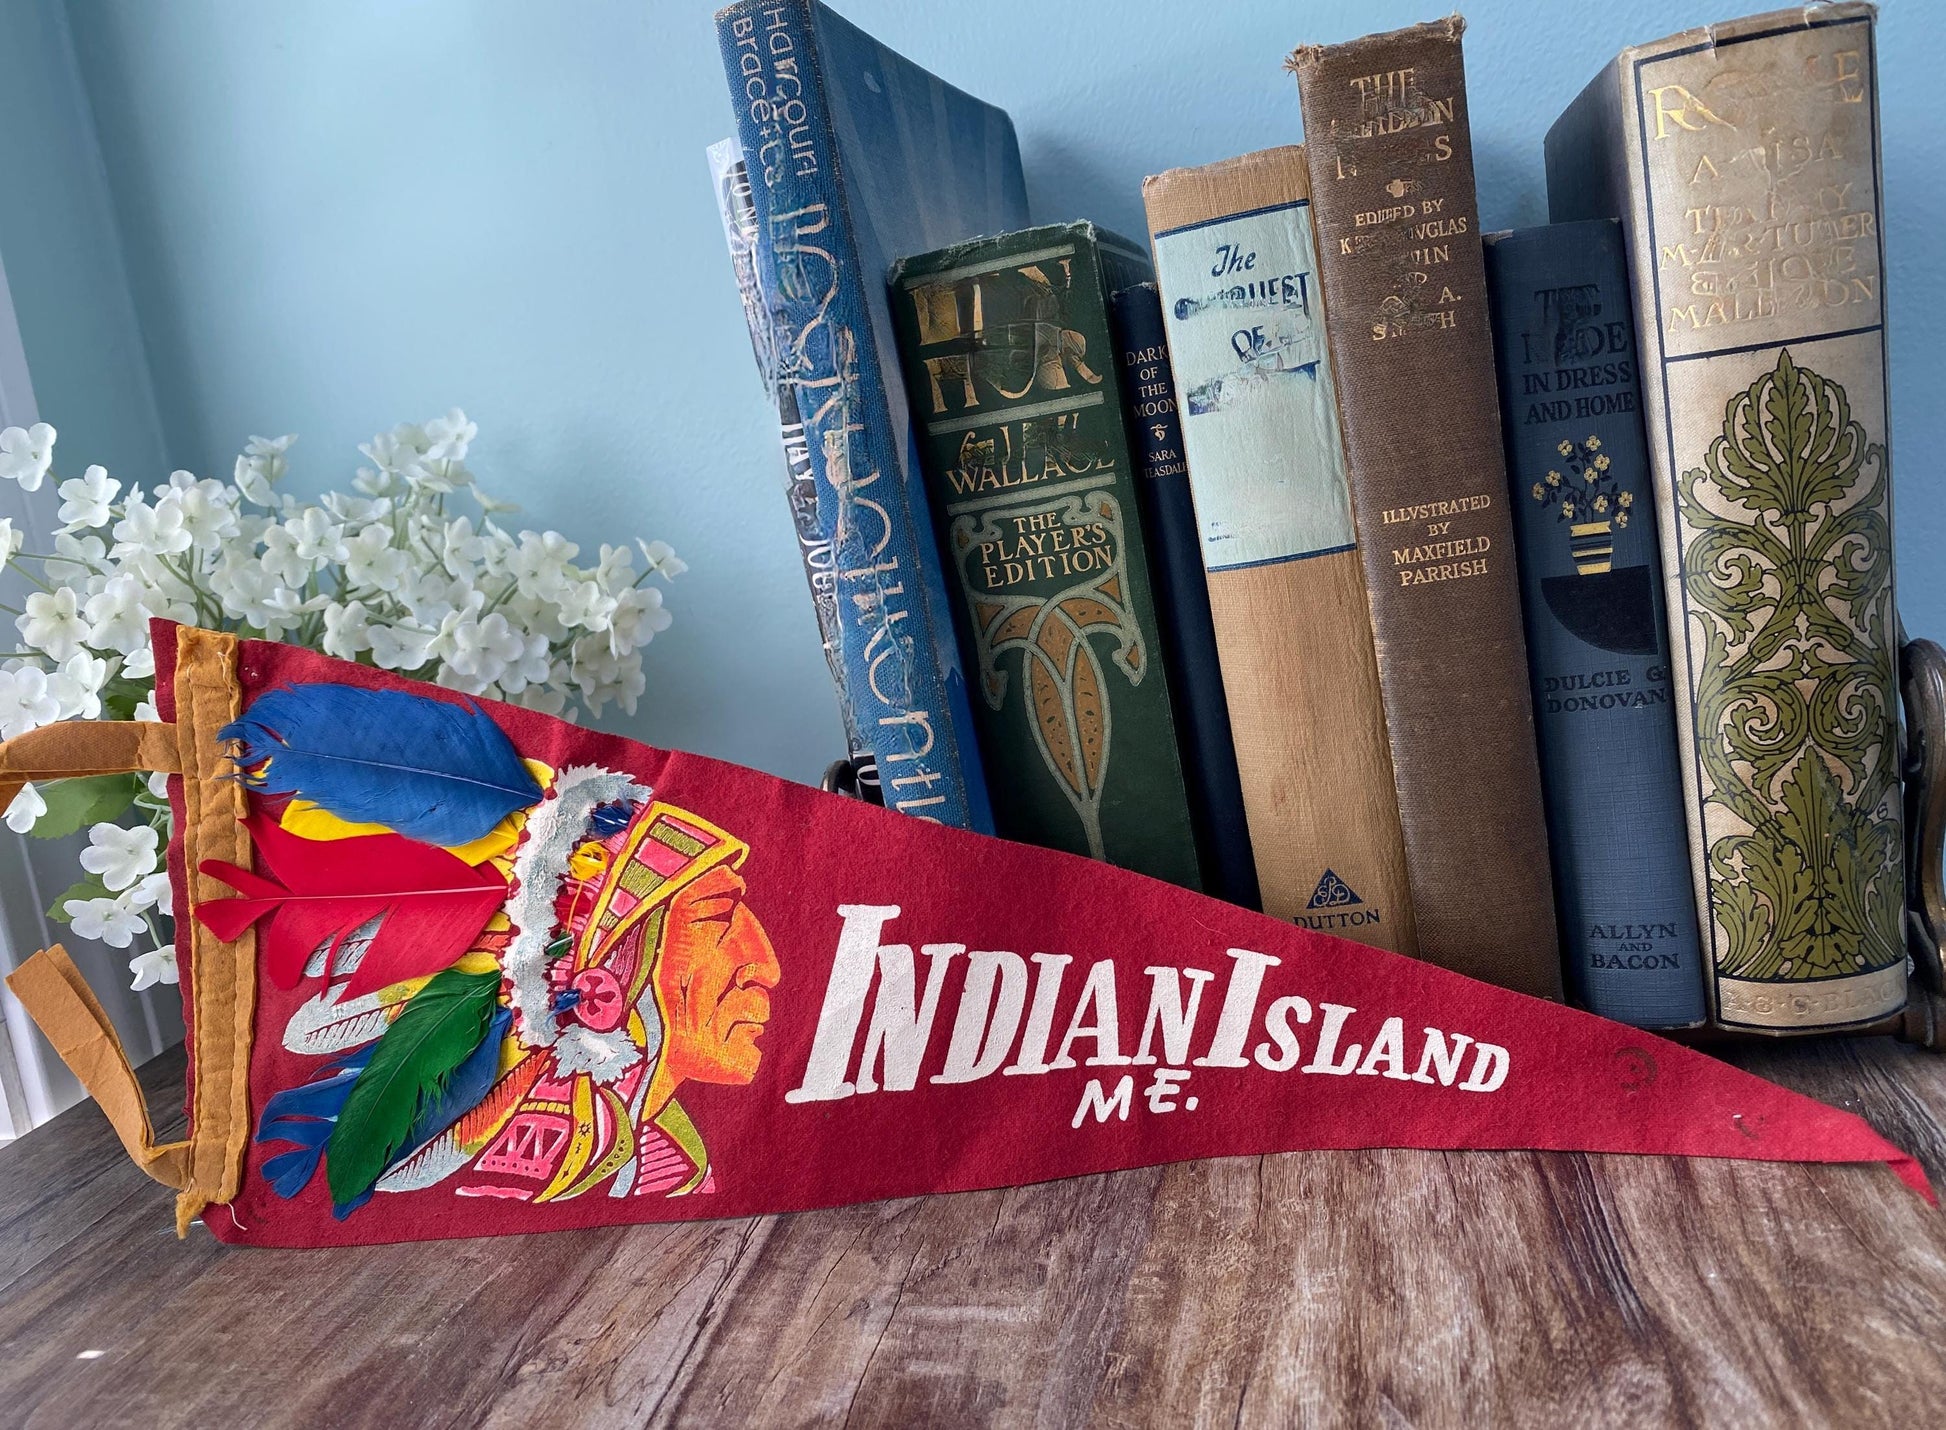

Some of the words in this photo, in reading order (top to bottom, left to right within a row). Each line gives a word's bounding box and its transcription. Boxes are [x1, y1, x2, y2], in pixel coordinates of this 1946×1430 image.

[1422, 198, 1445, 215] BY
[1211, 243, 1257, 278] The
[1126, 345, 1169, 366] DARK
[1140, 366, 1158, 381] OF
[1522, 373, 1549, 395] IN
[1556, 361, 1632, 392] DRESS
[1138, 382, 1168, 398] THE
[1133, 399, 1178, 418] MOON
[1524, 400, 1571, 425] AND
[1575, 391, 1635, 419] HOME
[1148, 448, 1177, 462] SARA
[1382, 494, 1491, 524] ILLVSTRATED
[1013, 512, 1061, 534] THE
[1427, 522, 1451, 537] BY
[979, 522, 1107, 564] PLAYER'S
[1392, 536, 1491, 565] MAXFIELD
[984, 544, 1113, 588] EDITION
[1400, 558, 1488, 586] PARRISH
[1544, 669, 1631, 693] DULCIE
[1547, 688, 1668, 714] DONOVAN
[1293, 908, 1381, 930] DUTTON
[1589, 923, 1678, 939] ALLYN
[1619, 942, 1653, 952] AND
[1590, 953, 1681, 970] BACON
[785, 904, 1215, 1104] INDIAN
[1192, 948, 1511, 1093] ISLAND
